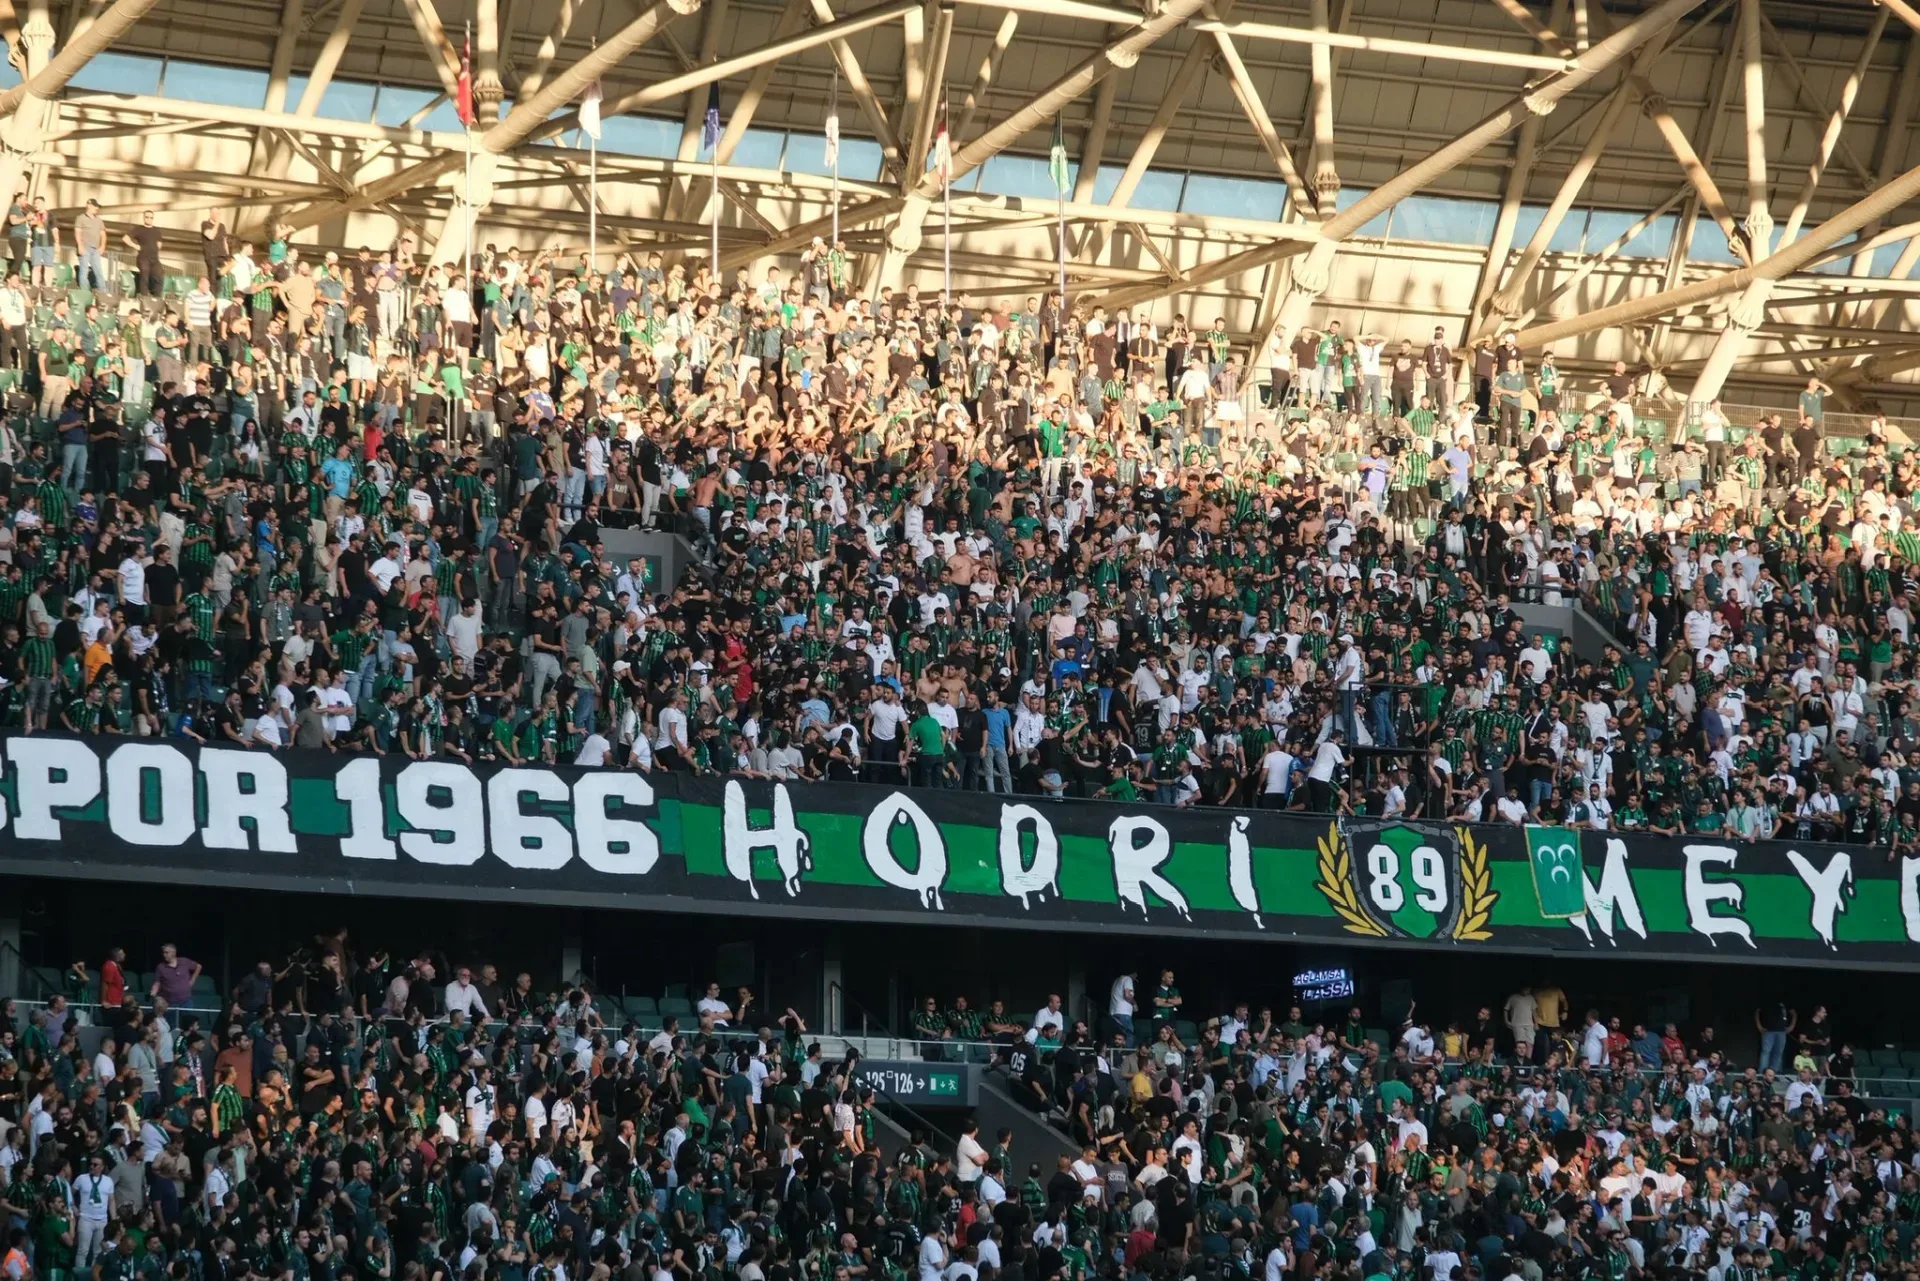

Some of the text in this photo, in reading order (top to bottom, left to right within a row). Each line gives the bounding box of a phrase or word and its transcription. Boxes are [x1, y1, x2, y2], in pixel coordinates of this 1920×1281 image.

[0, 737, 660, 874] POR 1966
[1368, 844, 1448, 913] 89
[866, 1071, 914, 1094] 125 126
